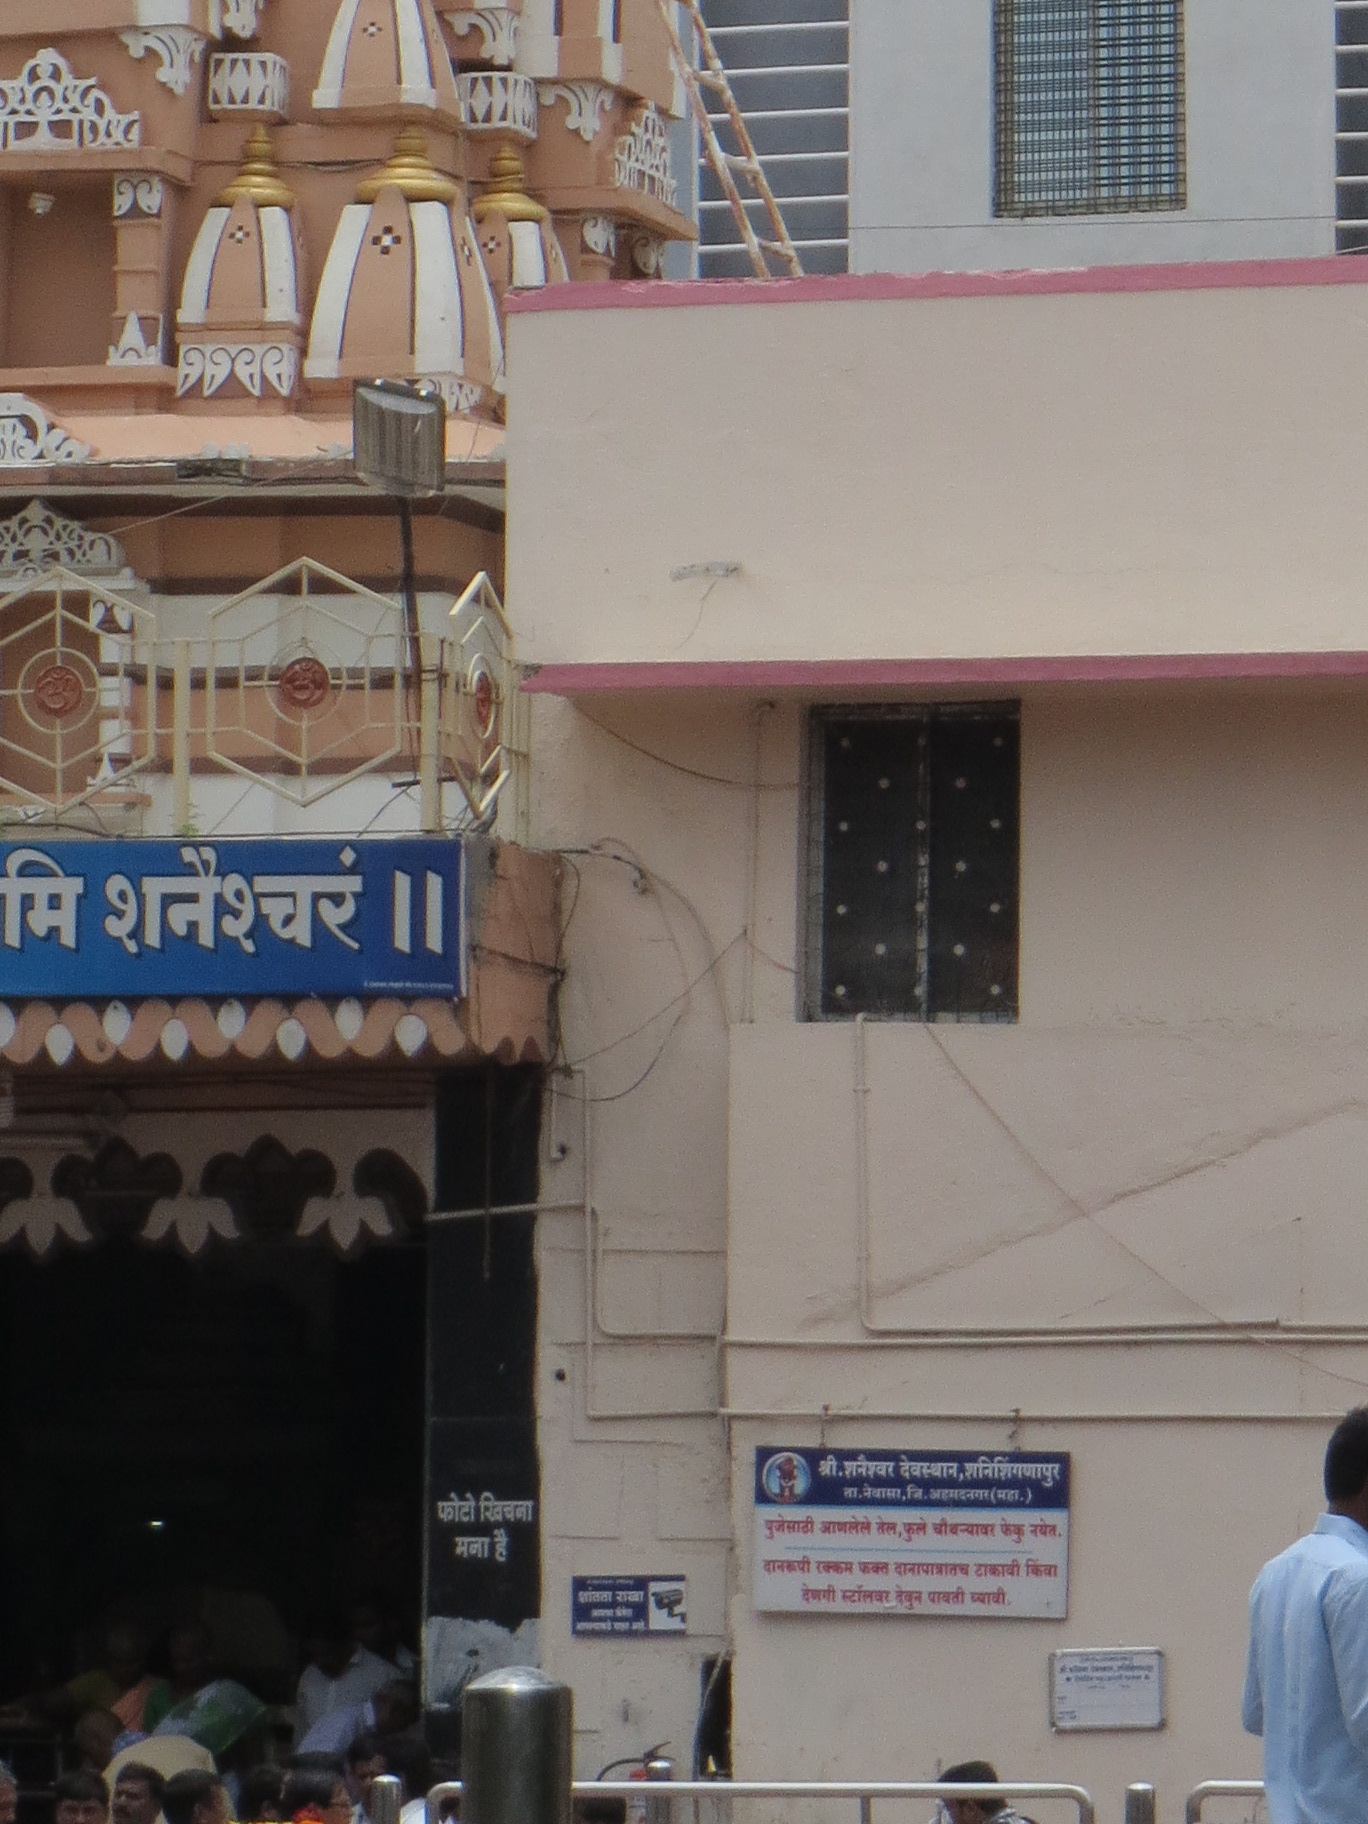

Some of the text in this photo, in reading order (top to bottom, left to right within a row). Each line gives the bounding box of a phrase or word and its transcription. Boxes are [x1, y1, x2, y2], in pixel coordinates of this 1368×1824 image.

[105, 844, 362, 956] शनैश्चरं
[455, 1529, 510, 1562] मना है
